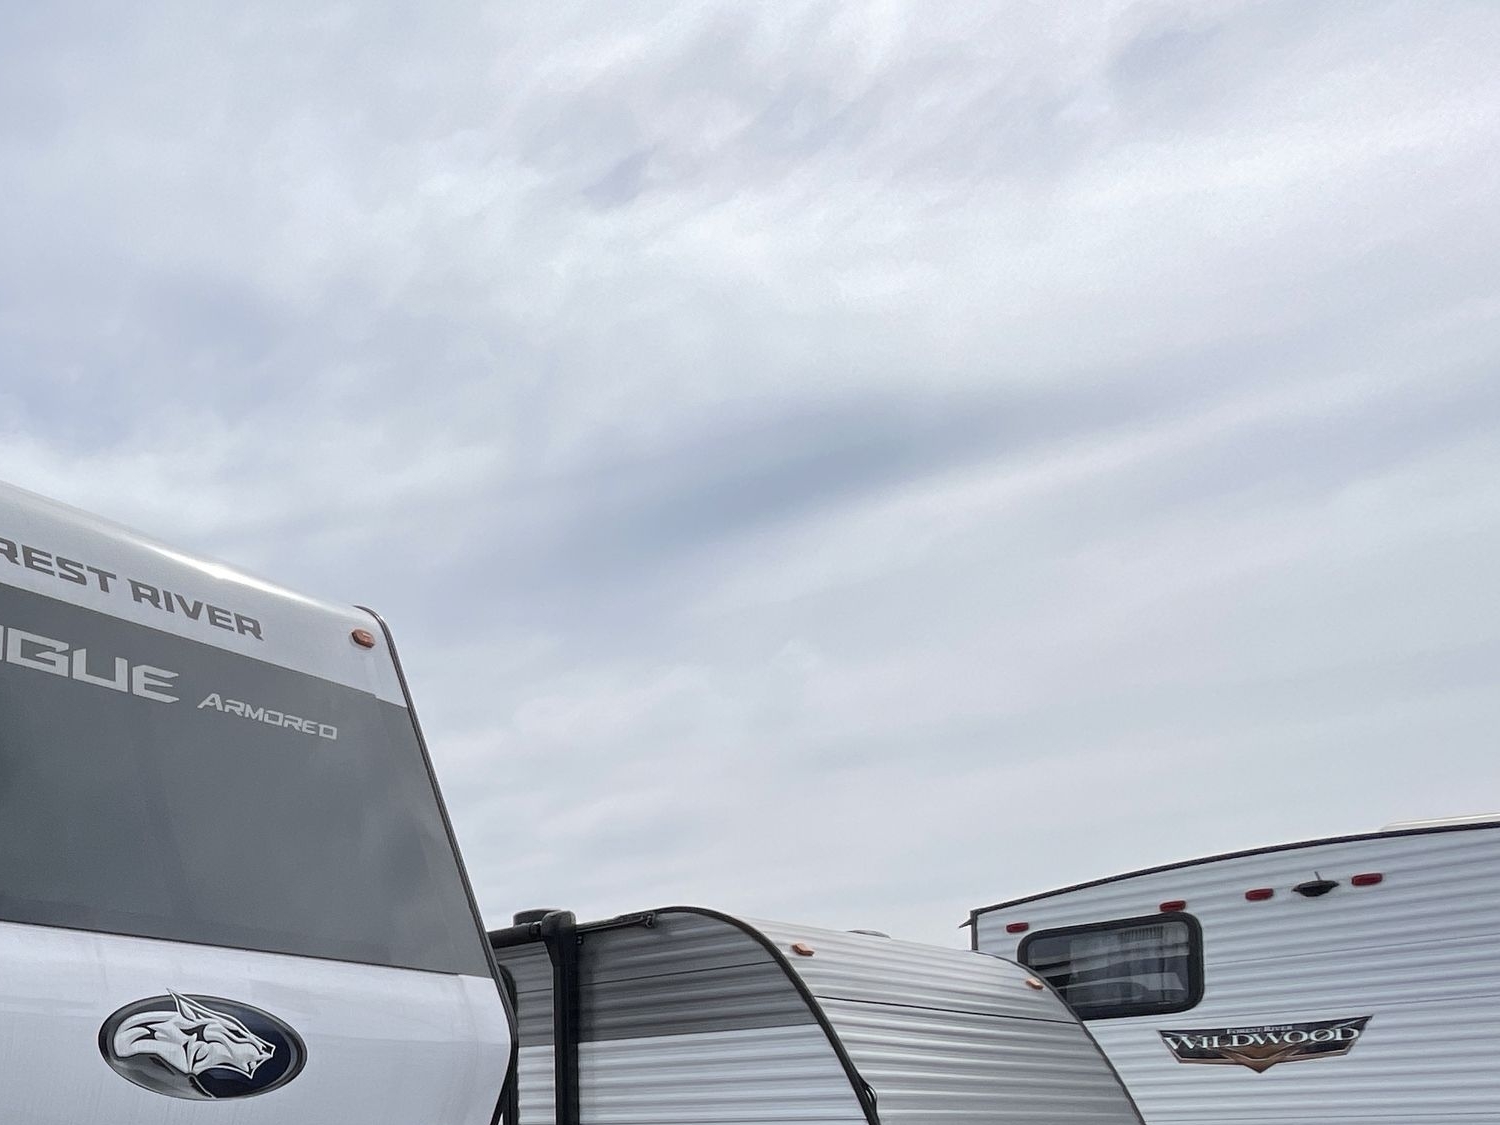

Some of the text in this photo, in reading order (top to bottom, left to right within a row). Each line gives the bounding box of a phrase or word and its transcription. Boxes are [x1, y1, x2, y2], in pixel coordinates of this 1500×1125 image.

[127, 578, 264, 641] RIVER
[197, 693, 338, 740] ARMORED
[1164, 1027, 1360, 1050] WILDWOOD
